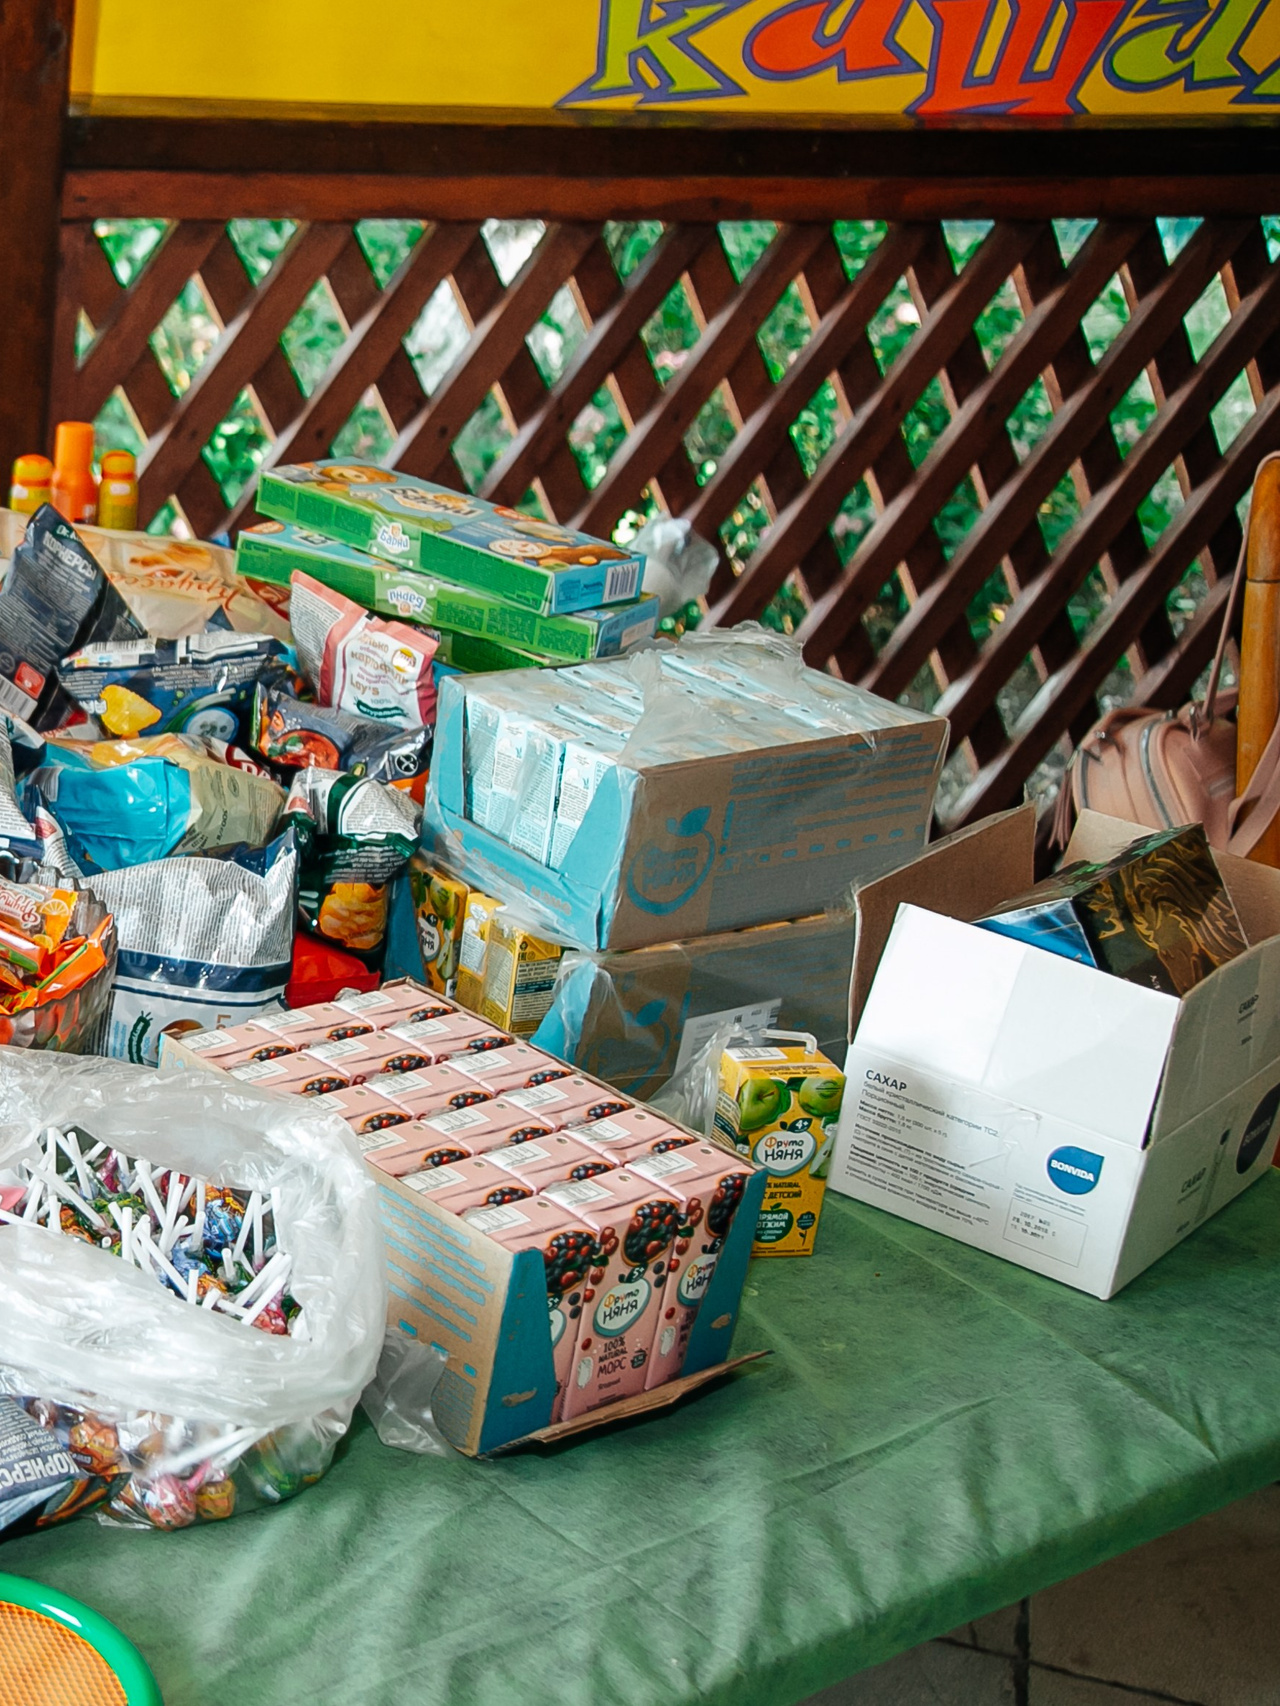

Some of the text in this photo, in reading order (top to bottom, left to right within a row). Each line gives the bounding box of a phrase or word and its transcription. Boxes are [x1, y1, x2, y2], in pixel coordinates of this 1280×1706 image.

[377, 528, 410, 549] Барни
[42, 530, 98, 581] КОРНЕРСЫ
[387, 589, 425, 609] Барни
[866, 1069, 907, 1092] САХАР
[863, 1081, 885, 1093] белый
[886, 1091, 946, 1117] кристаллический
[946, 1112, 983, 1131] категории
[795, 1119, 809, 1131] 4+
[764, 1135, 805, 1150] Фруто
[764, 1148, 804, 1164] НЯНЯ
[1050, 1159, 1095, 1183] BONVIDA
[768, 1190, 802, 1200] ДЕТСКИЙ
[604, 1288, 640, 1308] Фруто
[603, 1300, 639, 1325] НЯНЯ
[603, 1336, 626, 1349] 100%
[597, 1357, 627, 1378] МОРС
